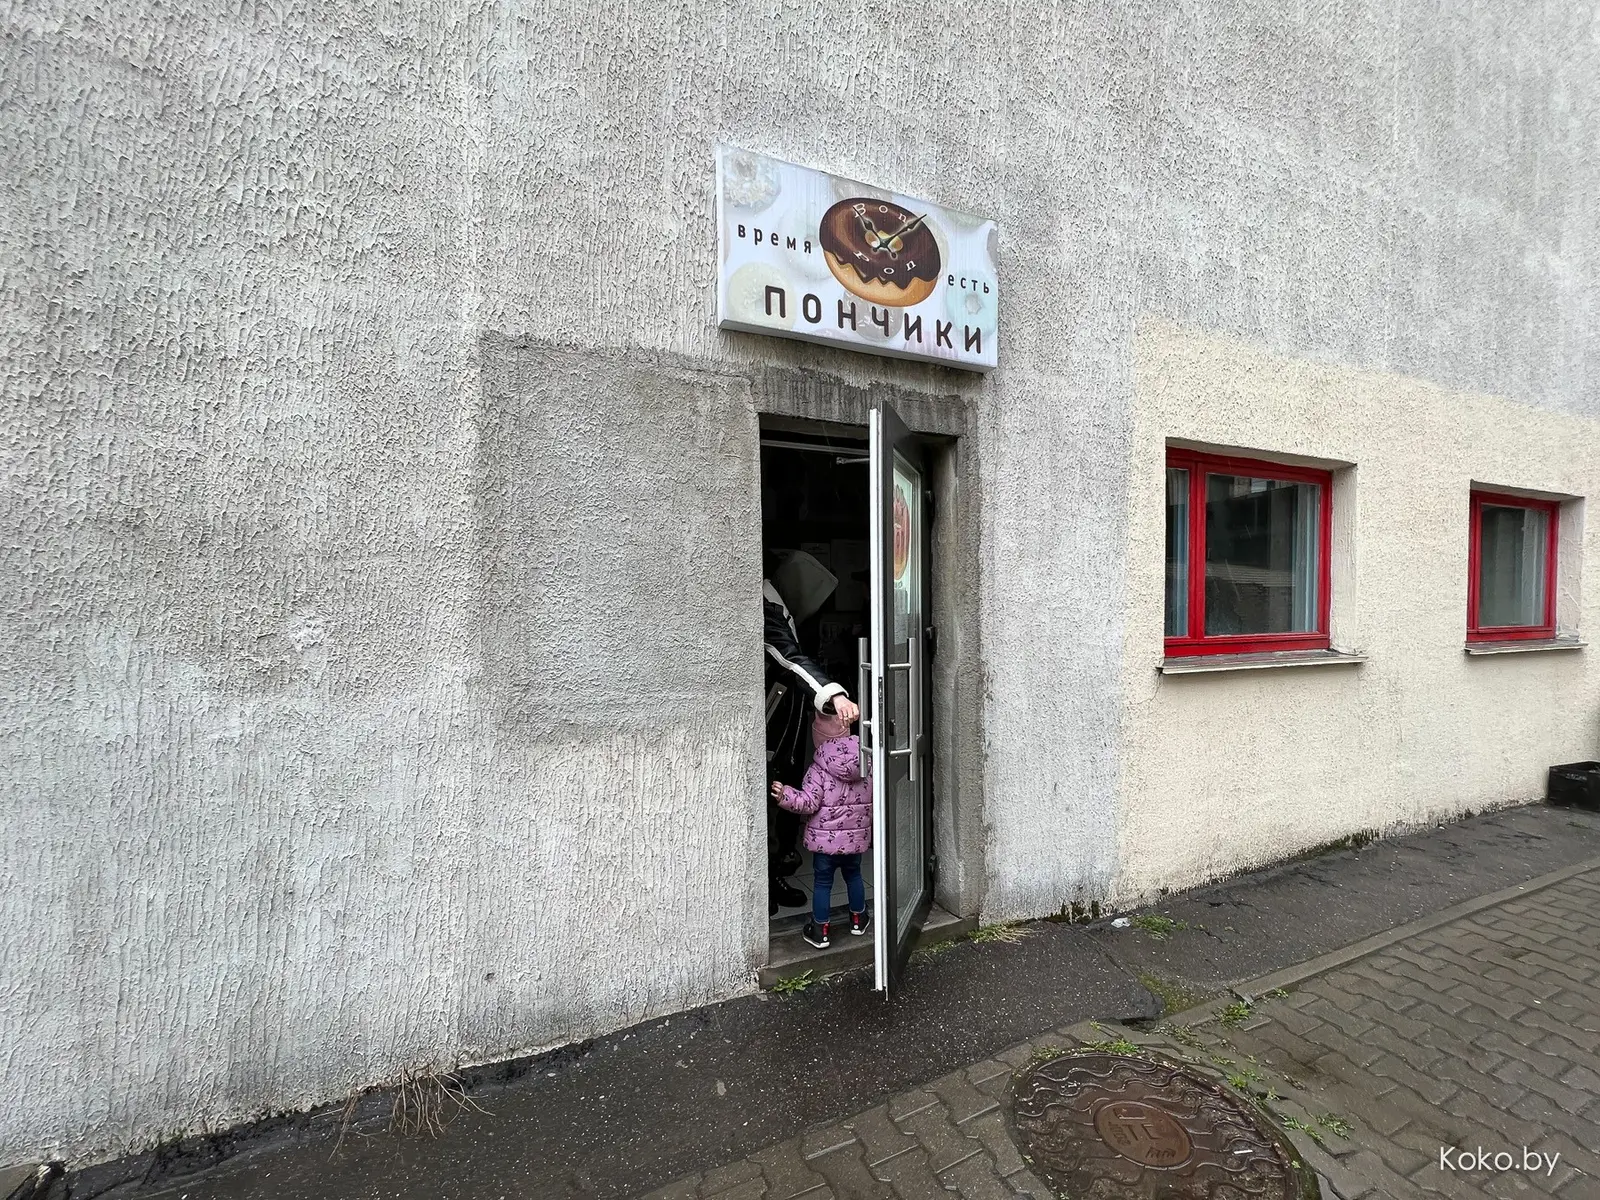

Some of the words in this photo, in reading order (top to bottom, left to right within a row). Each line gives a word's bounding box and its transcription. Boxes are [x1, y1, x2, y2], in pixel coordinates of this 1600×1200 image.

[737, 224, 812, 254] время
[947, 274, 990, 294] есть
[764, 284, 982, 354] ПОНЧИКИ
